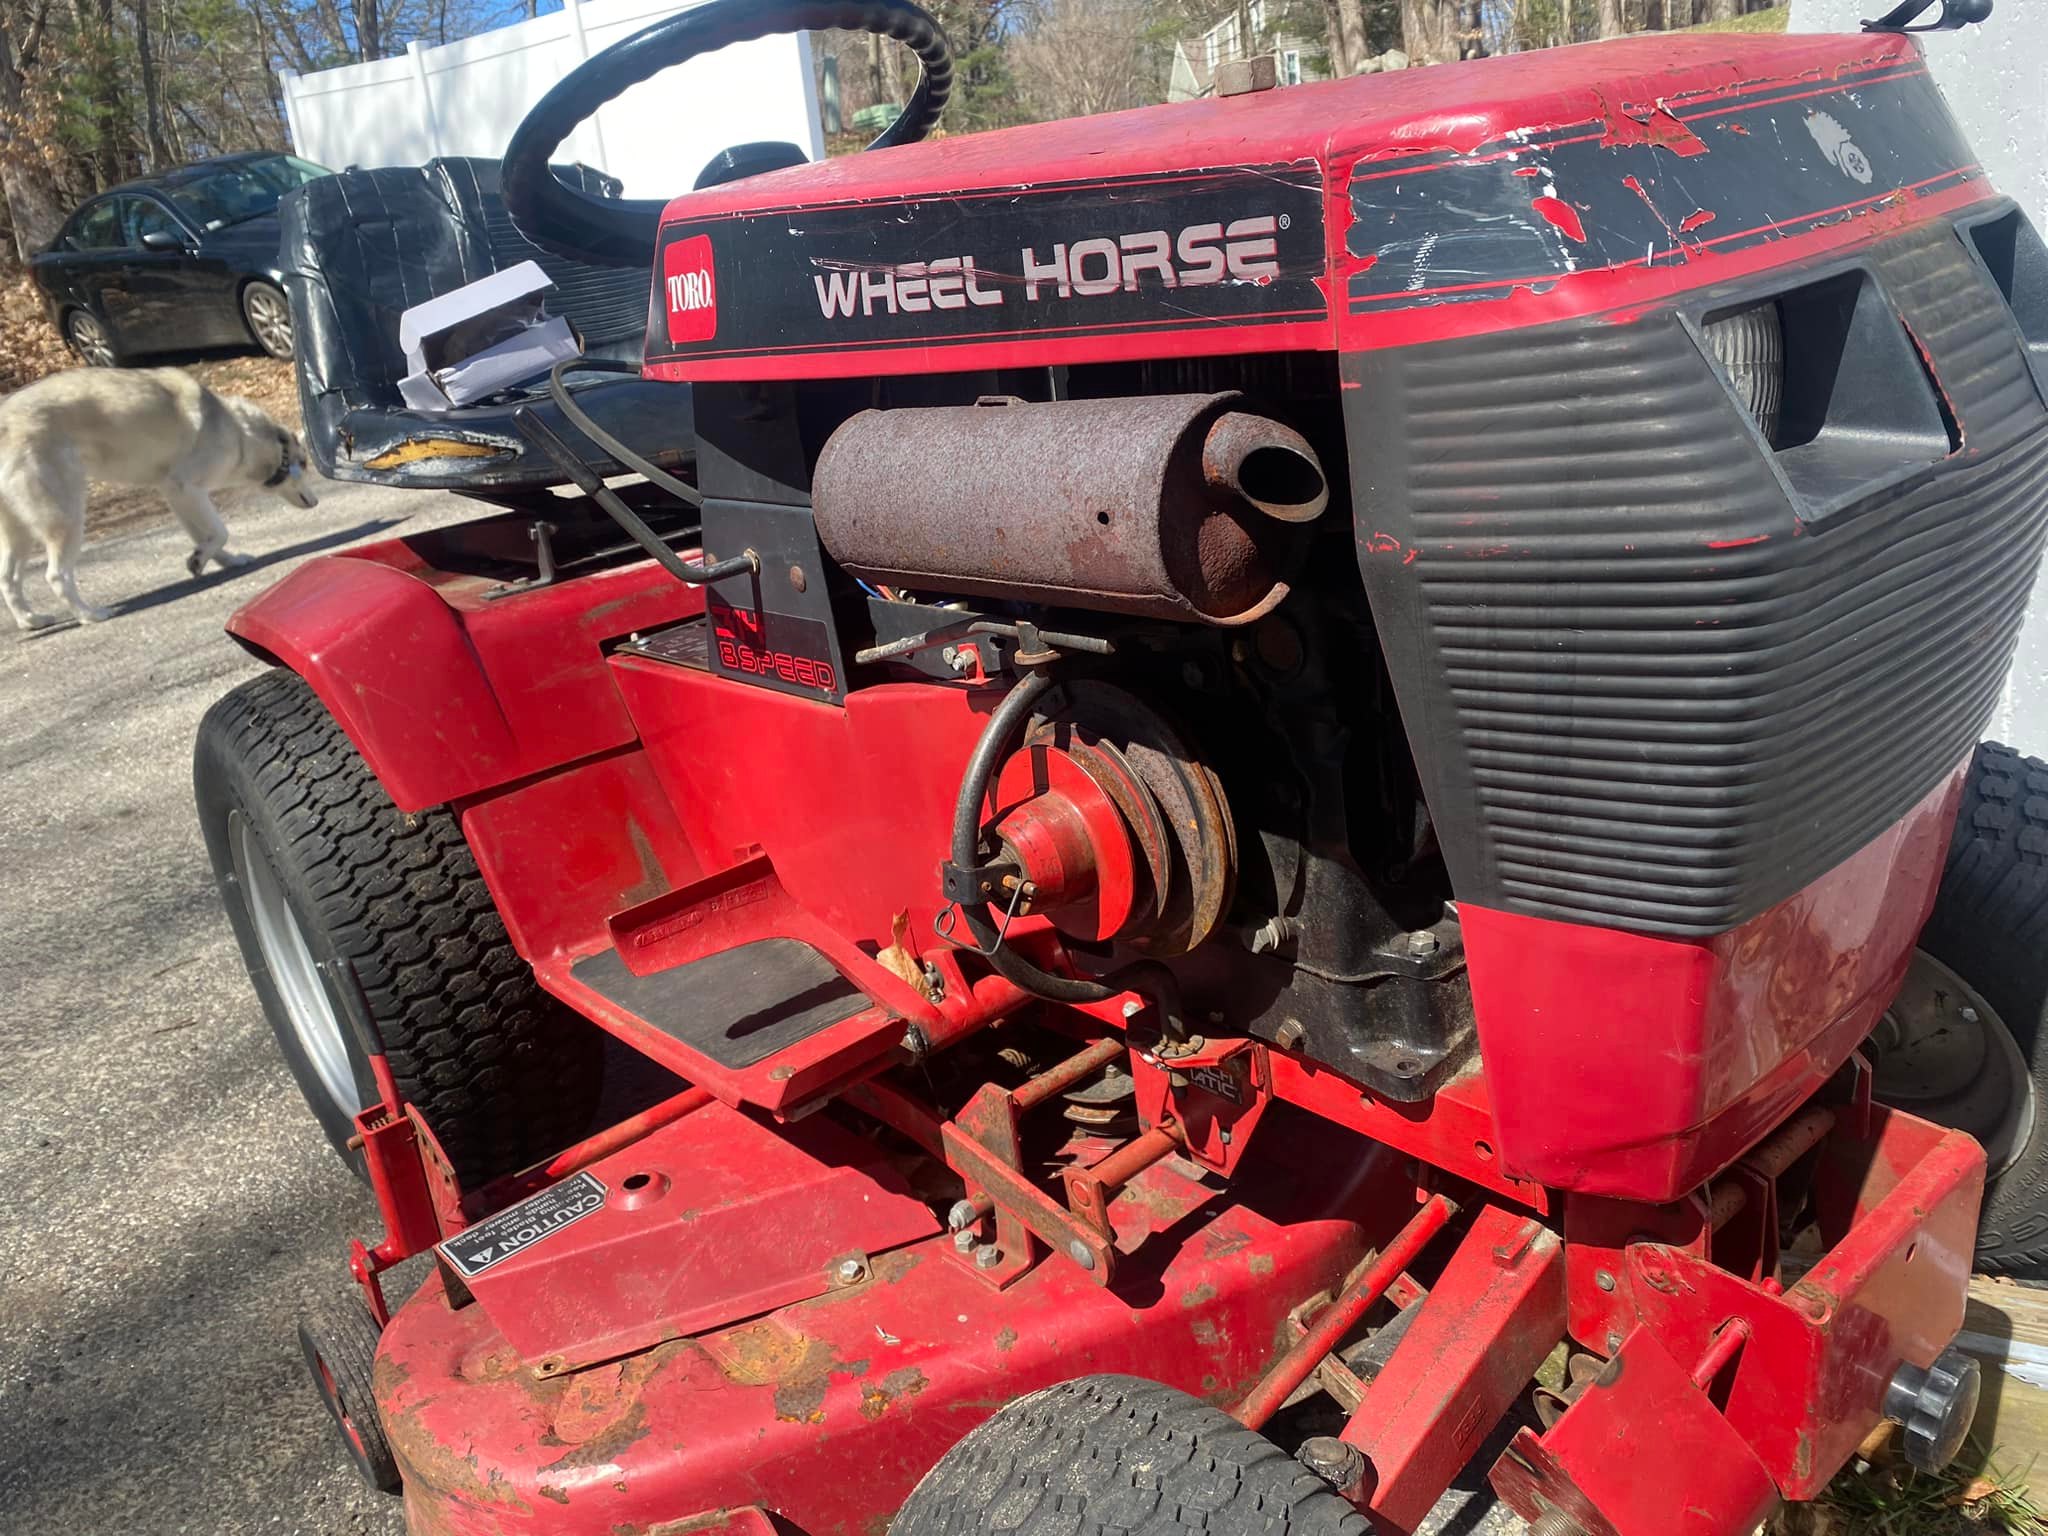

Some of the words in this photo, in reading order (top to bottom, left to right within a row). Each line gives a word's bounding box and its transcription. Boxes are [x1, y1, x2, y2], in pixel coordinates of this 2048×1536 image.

[666, 268, 713, 314] TORO
[814, 255, 1003, 319] WHEEL
[498, 1195, 601, 1252] CAUTION
[500, 1216, 521, 1231] and
